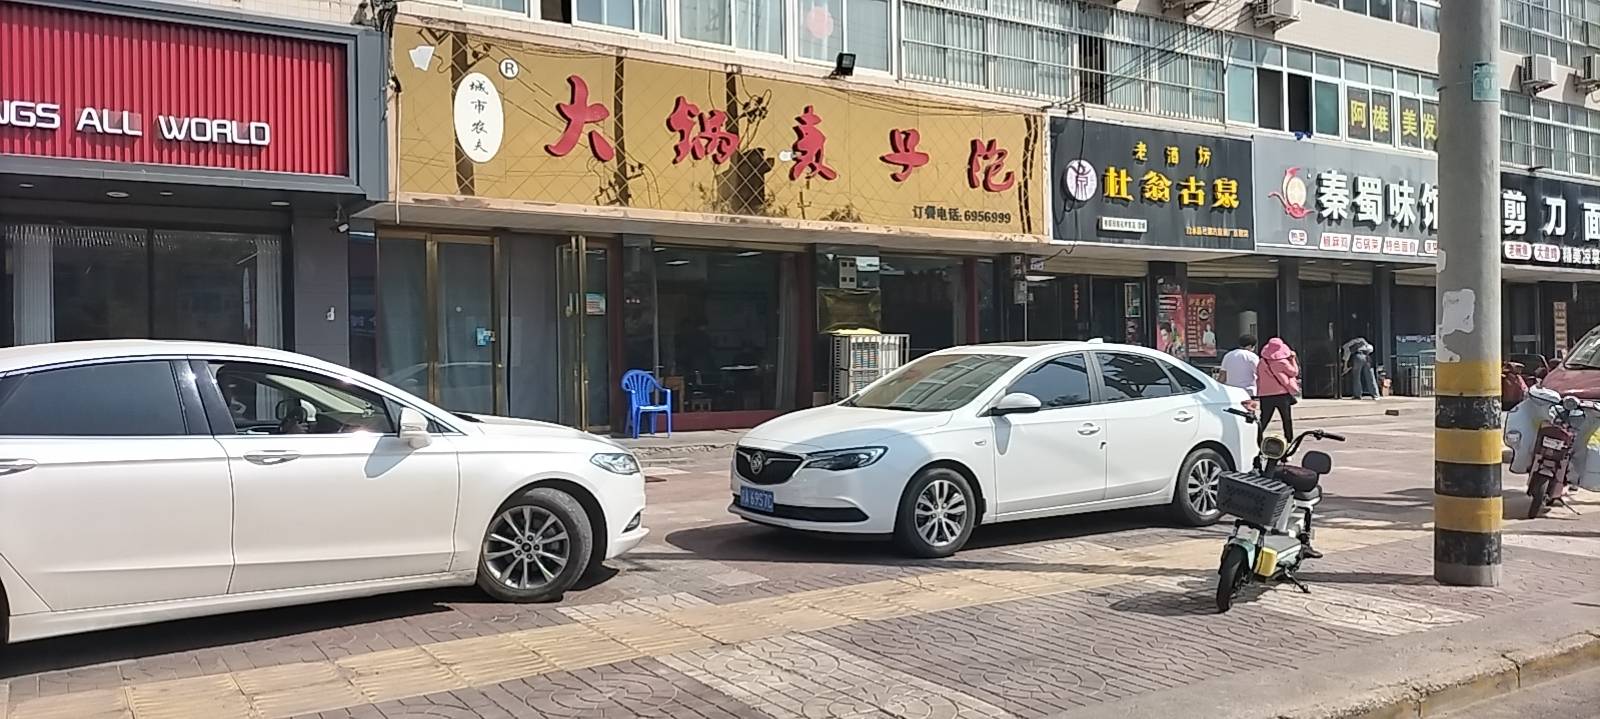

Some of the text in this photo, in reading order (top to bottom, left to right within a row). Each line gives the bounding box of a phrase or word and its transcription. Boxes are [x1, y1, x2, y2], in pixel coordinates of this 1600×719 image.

[76, 107, 142, 136] ALL
[158, 115, 270, 146] WORLD
[469, 79, 489, 153] 城市农夫
[1350, 99, 1438, 140] 阿雄美发
[1134, 141, 1213, 168] 老酒坊
[1104, 165, 1240, 209] 杜翁古泉
[1502, 189, 1600, 241] 剪刀面
